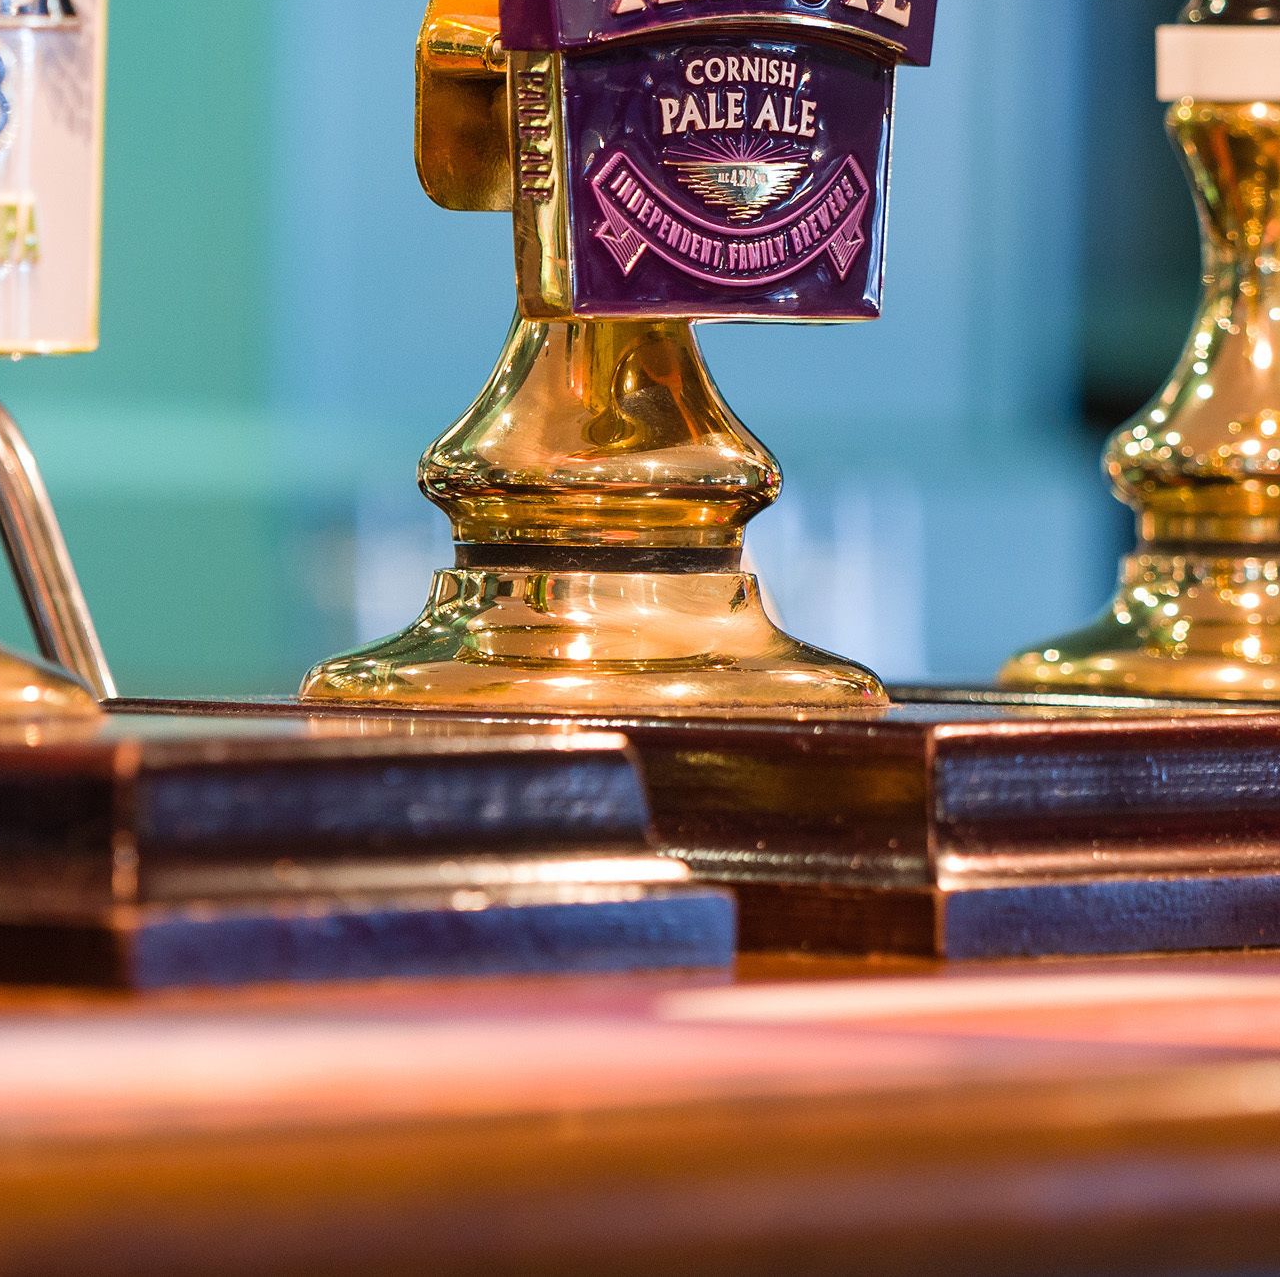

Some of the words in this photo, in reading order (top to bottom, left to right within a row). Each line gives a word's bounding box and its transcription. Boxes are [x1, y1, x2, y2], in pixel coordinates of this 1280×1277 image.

[685, 56, 797, 88] CORNISH
[518, 67, 550, 140] PALE
[659, 92, 744, 135] PALE
[752, 95, 818, 138] ALE
[520, 148, 554, 201] ALE
[609, 171, 723, 268] INDEPENDENT
[728, 233, 786, 270] FAMILY
[790, 175, 856, 253] BREWERS
